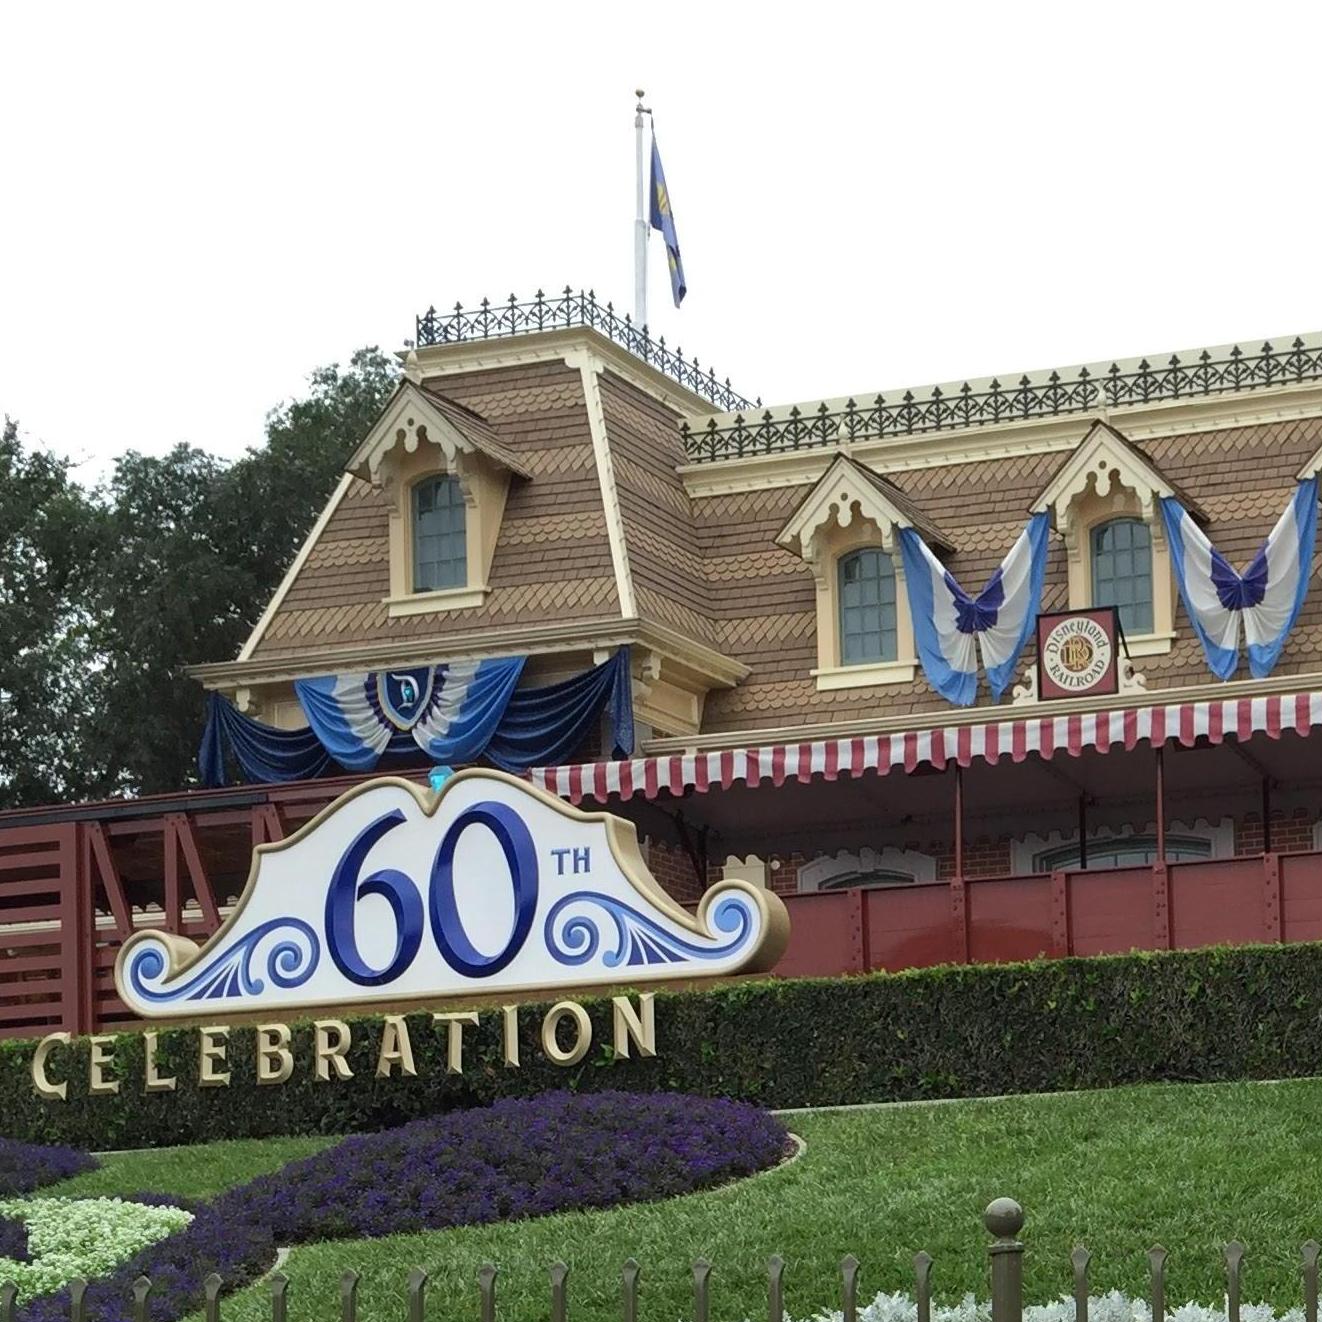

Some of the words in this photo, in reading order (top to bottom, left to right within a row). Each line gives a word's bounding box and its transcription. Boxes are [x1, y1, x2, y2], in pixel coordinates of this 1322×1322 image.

[1047, 620, 1109, 654] Disneyland
[1050, 660, 1105, 687] RAILROAD
[32, 993, 657, 1099] CELEBRATION
